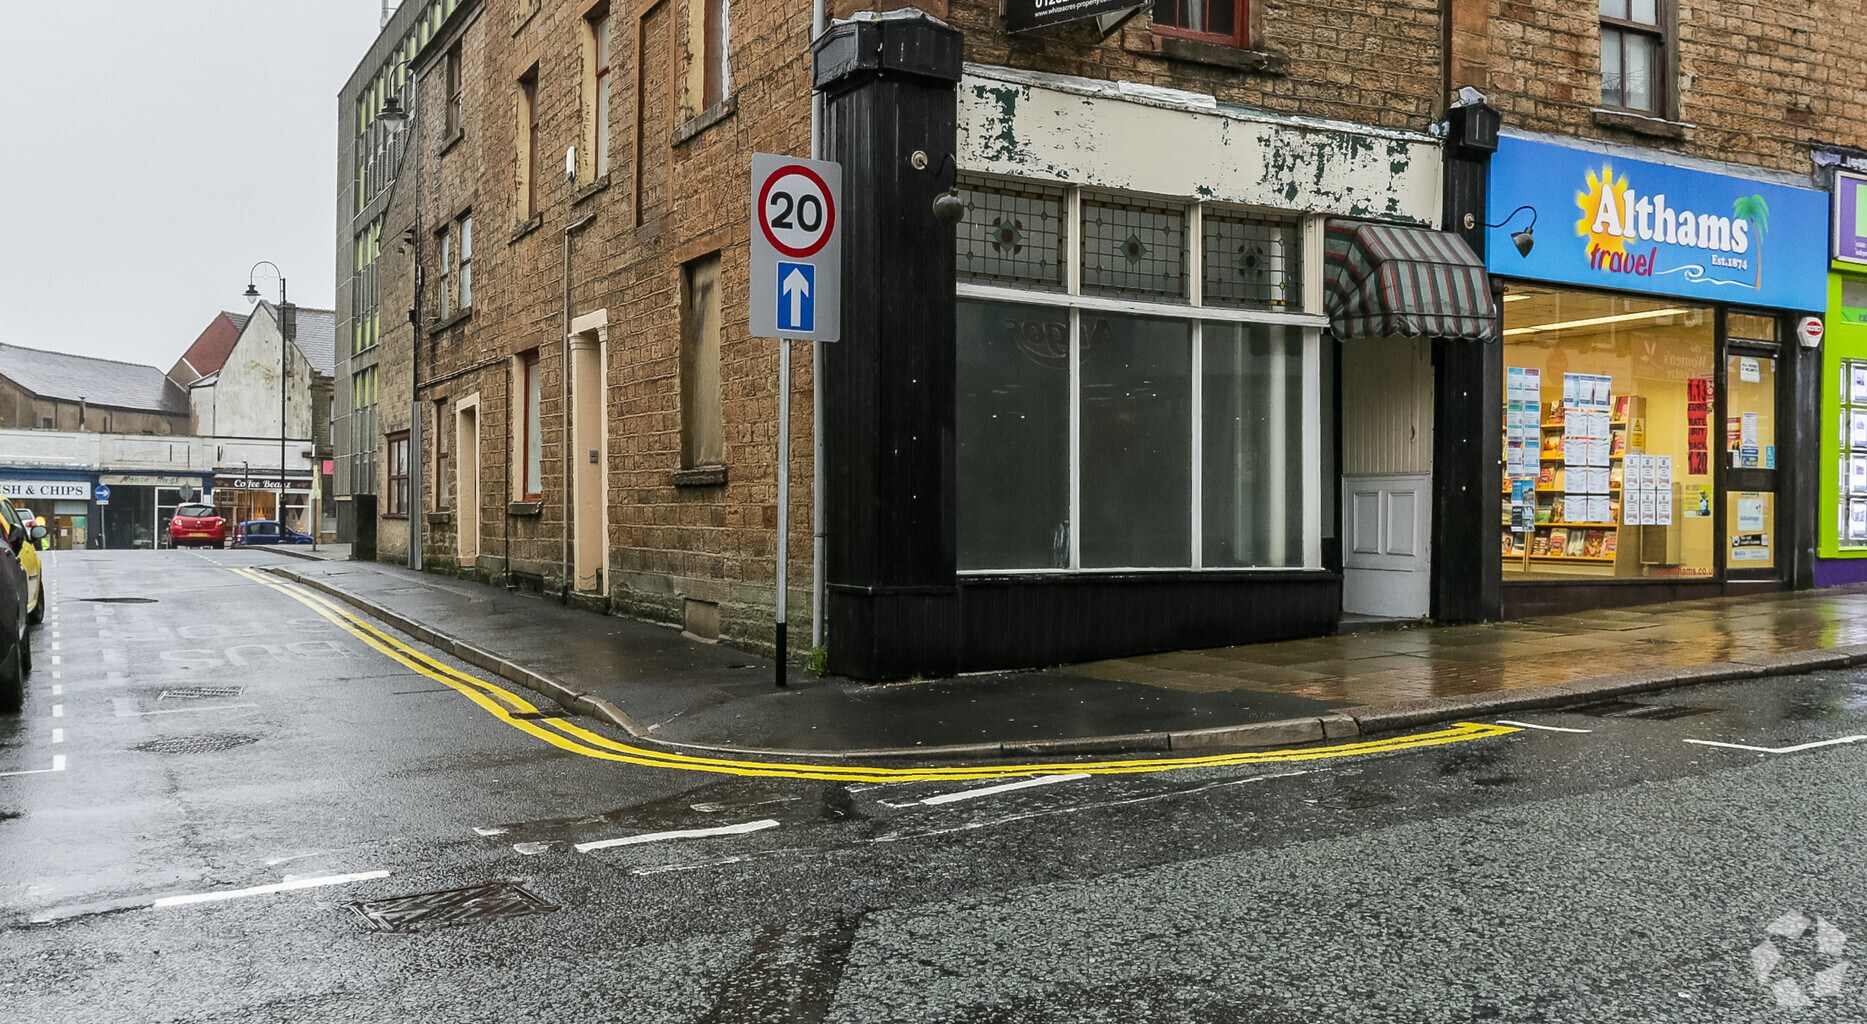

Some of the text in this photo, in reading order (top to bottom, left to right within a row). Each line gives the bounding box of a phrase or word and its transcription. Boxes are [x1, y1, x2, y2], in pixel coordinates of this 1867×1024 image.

[770, 191, 823, 233] 20
[1591, 183, 1749, 254] Althams
[1590, 242, 1659, 277] travel
[1711, 254, 1748, 271] Est.1874
[1688, 403, 1707, 412] EURO
[1688, 418, 1707, 427] RATE
[1690, 428, 1704, 436] BUY
[234, 479, 260, 488] Cofee
[25, 485, 36, 495] &
[40, 485, 84, 496] CHIPS
